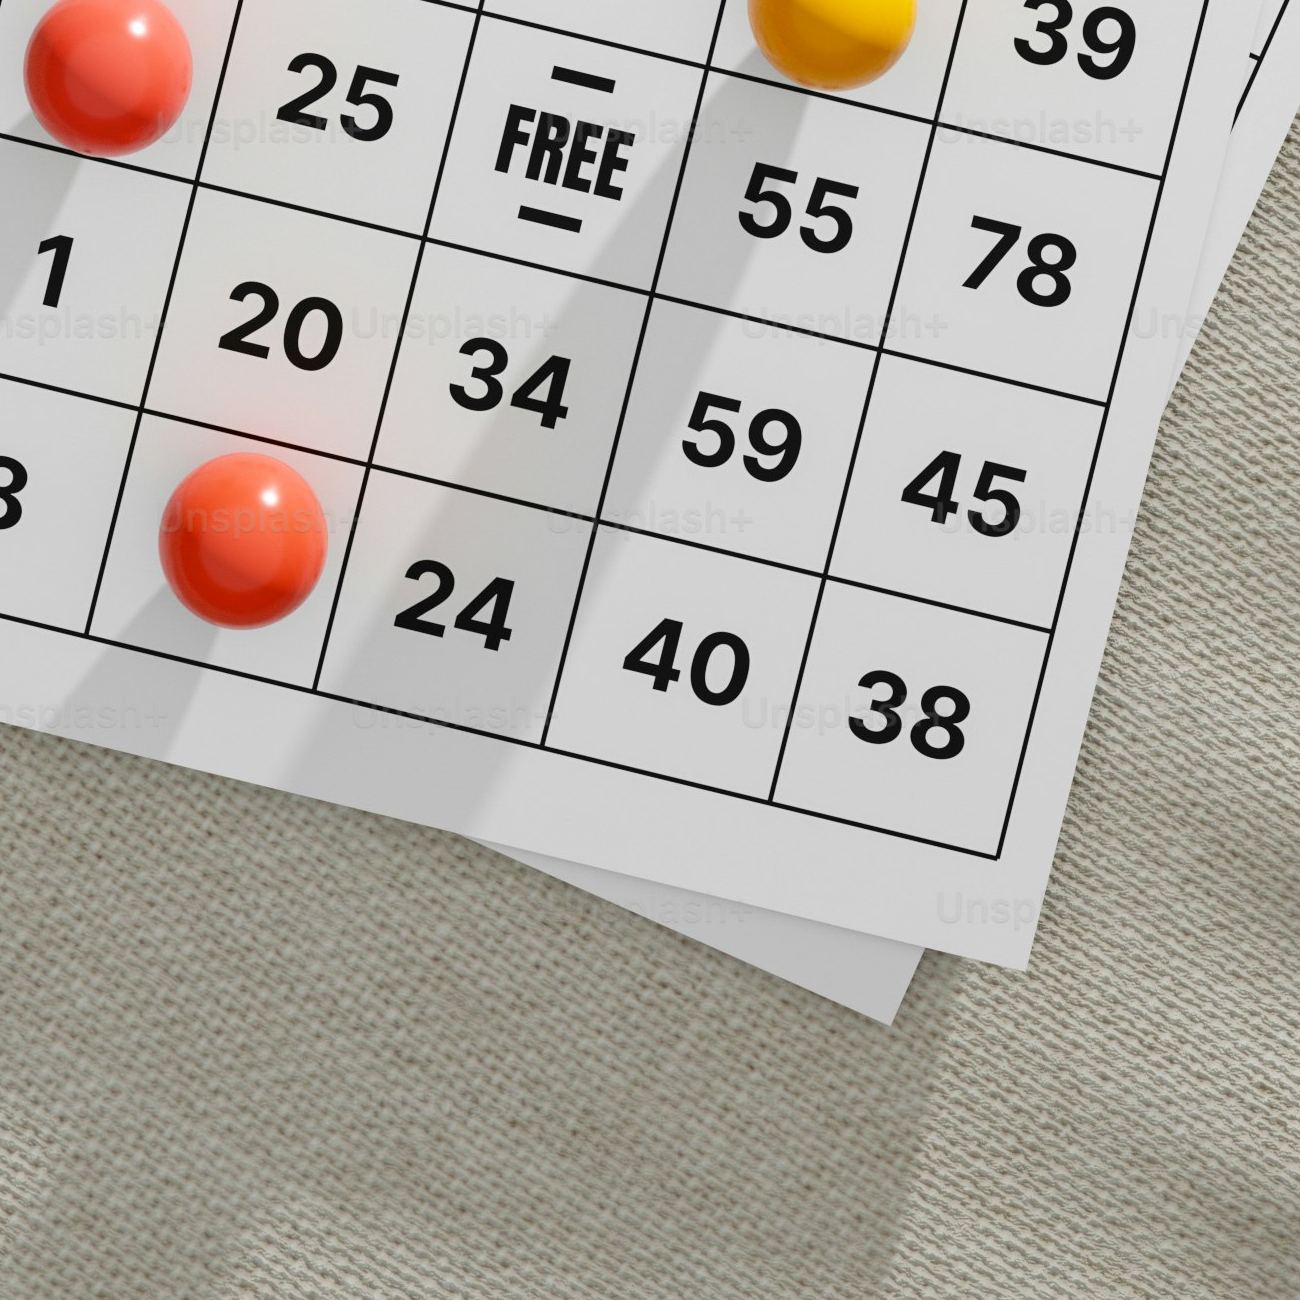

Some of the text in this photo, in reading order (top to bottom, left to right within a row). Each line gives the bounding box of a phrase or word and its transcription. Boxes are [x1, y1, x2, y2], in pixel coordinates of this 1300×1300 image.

[276, 52, 1077, 308] 25 FREE 55 78
[37, 234, 1027, 538] 1 20 34 59 45
[393, 559, 515, 652] 24
[622, 618, 750, 706] 40
[848, 670, 971, 760] 38
